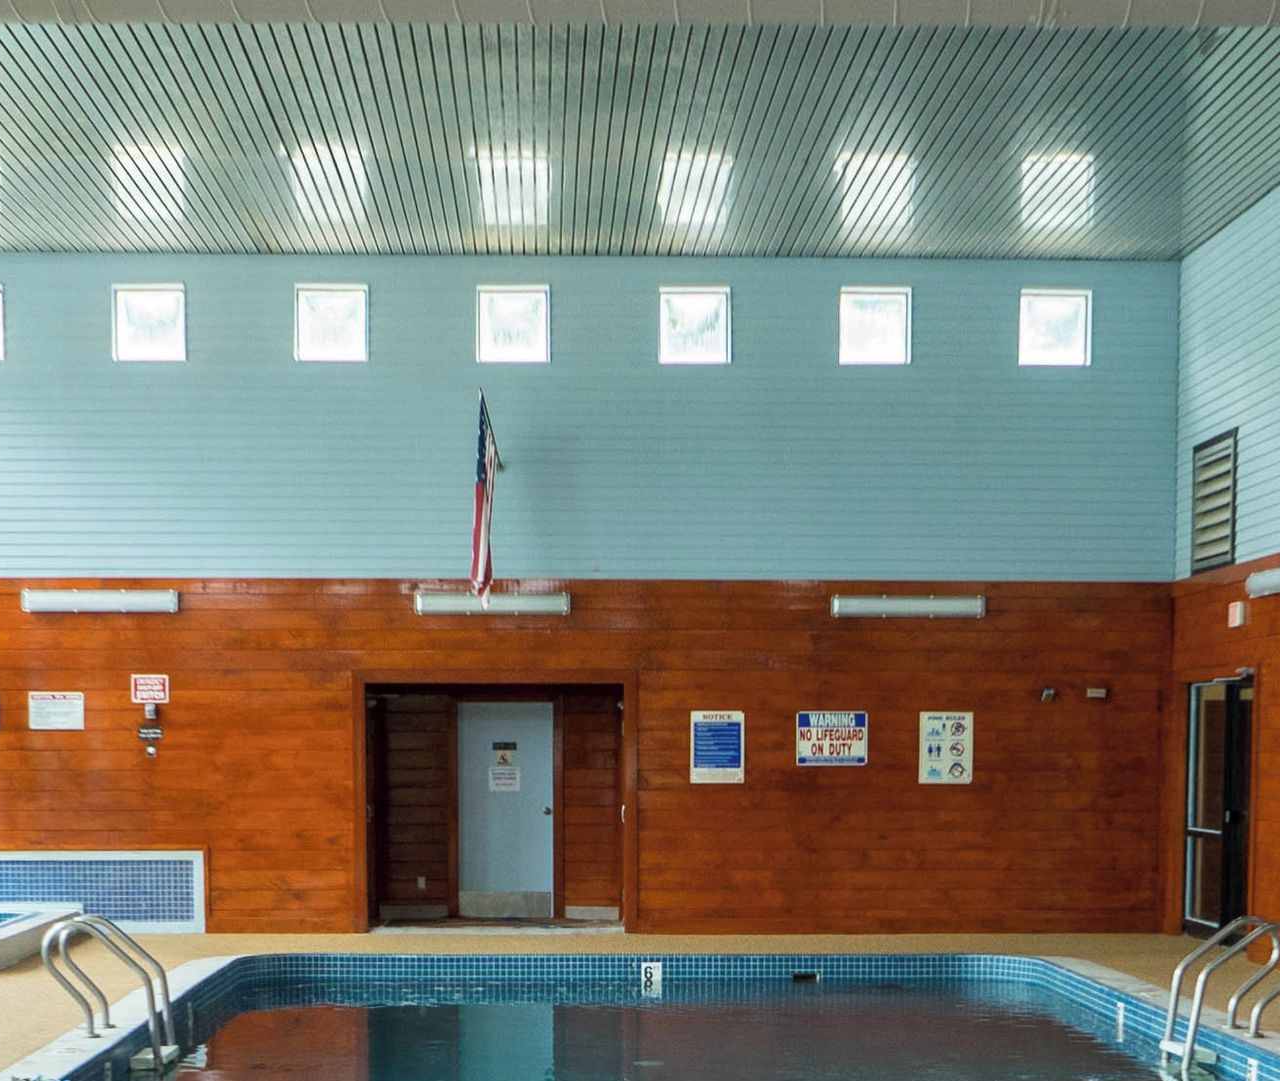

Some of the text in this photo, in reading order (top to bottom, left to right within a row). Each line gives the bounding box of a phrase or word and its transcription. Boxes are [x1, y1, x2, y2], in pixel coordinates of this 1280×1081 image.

[809, 713, 855, 727] WARNING
[800, 729, 864, 741] NO LIFEGUARD
[811, 743, 852, 756] ON DUTY
